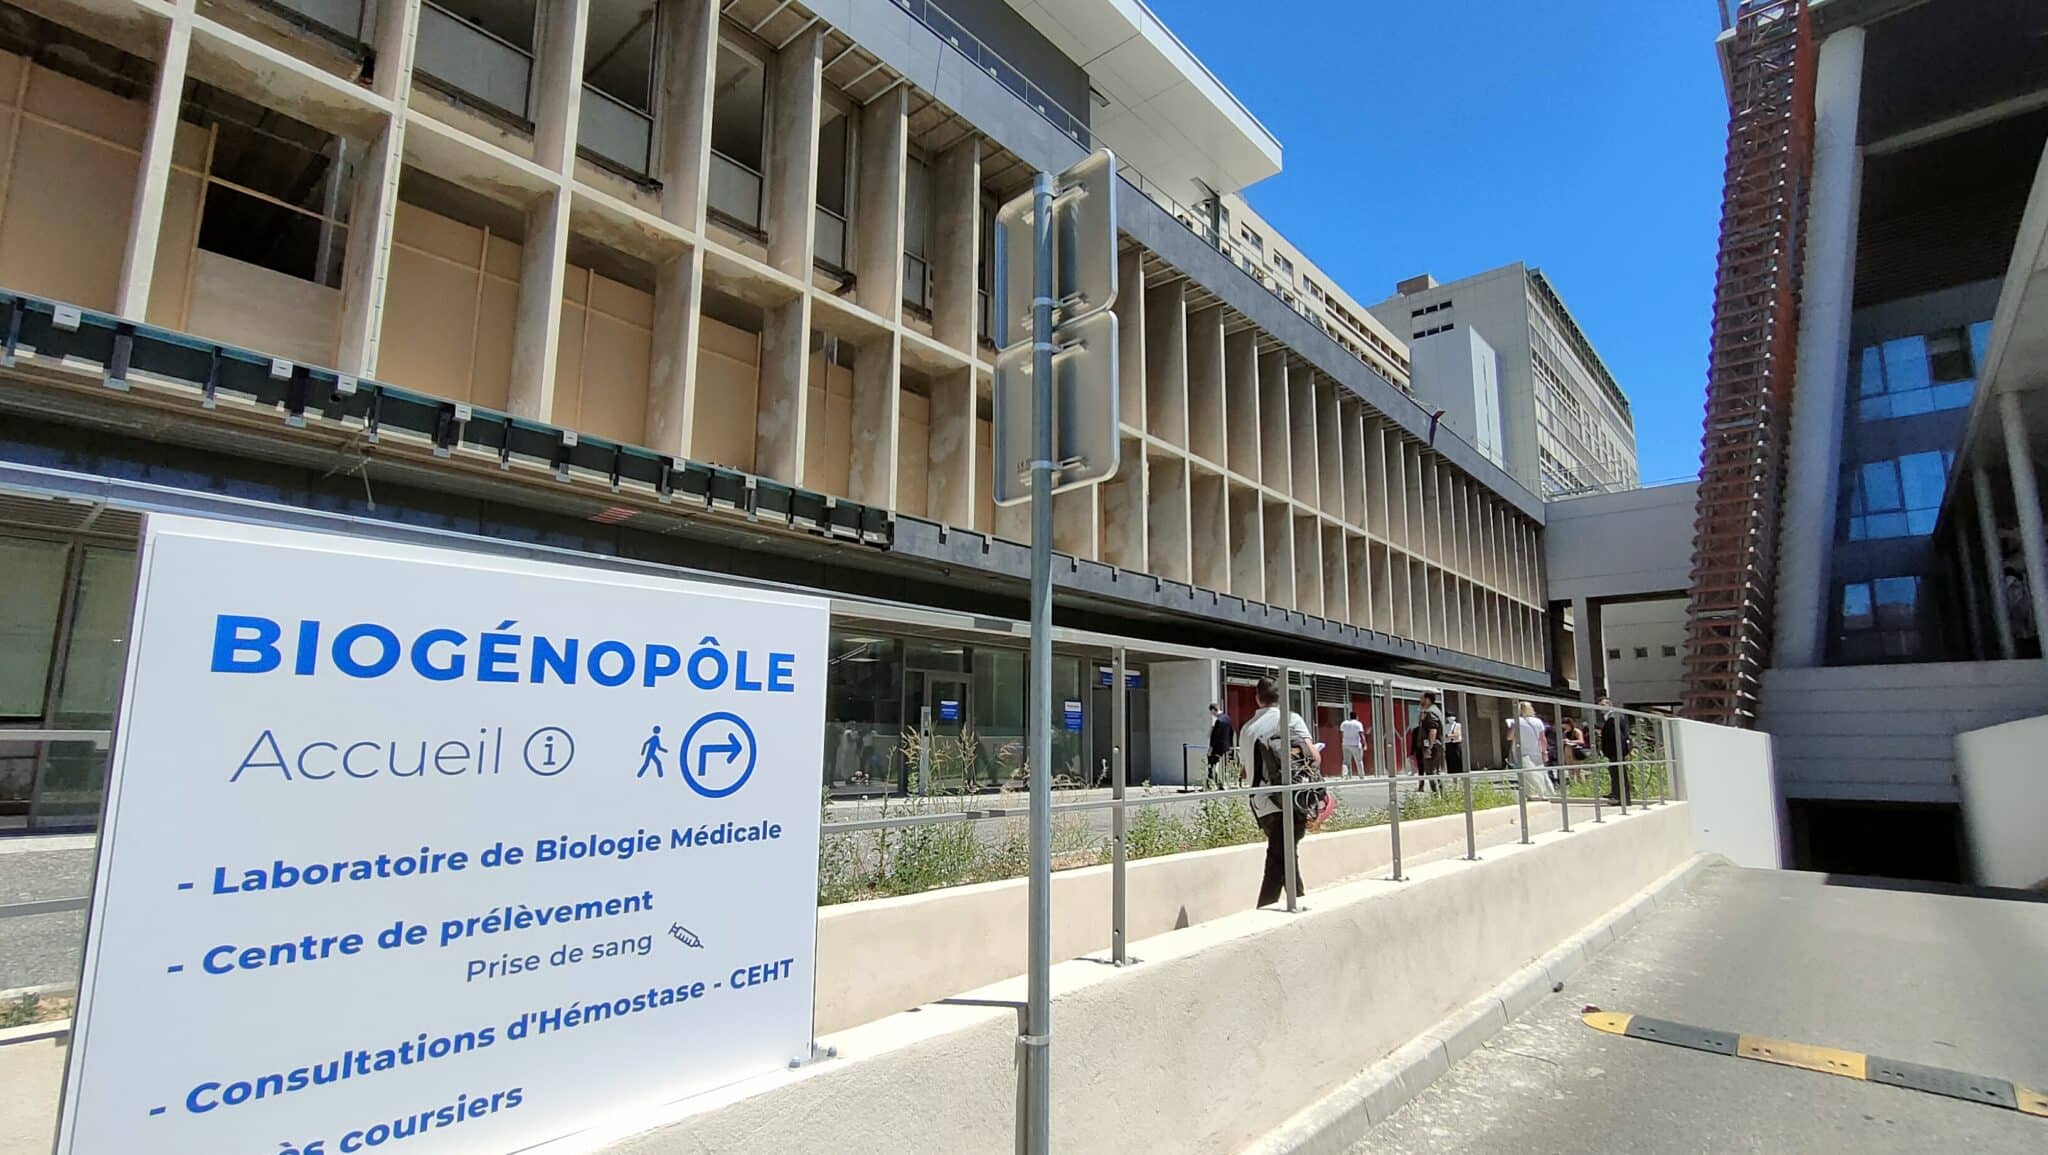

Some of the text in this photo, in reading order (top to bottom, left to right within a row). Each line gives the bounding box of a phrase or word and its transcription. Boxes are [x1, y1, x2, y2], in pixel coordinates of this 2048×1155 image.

[208, 612, 797, 694] BIOGÉNOPÔLE
[229, 726, 503, 784] Accueil
[211, 846, 470, 896] Laboratoire
[479, 841, 525, 869] de
[535, 828, 662, 865] Biologie
[670, 821, 783, 850] Médicale
[201, 932, 365, 977] Centre
[376, 920, 429, 950] de
[439, 889, 654, 948] prélèvement
[466, 935, 653, 983] Prise de sang
[184, 1026, 497, 1115] Consultations
[506, 980, 706, 1041] d'Hémostase
[729, 959, 795, 991] CEHT
[338, 1087, 524, 1155] coursiers
